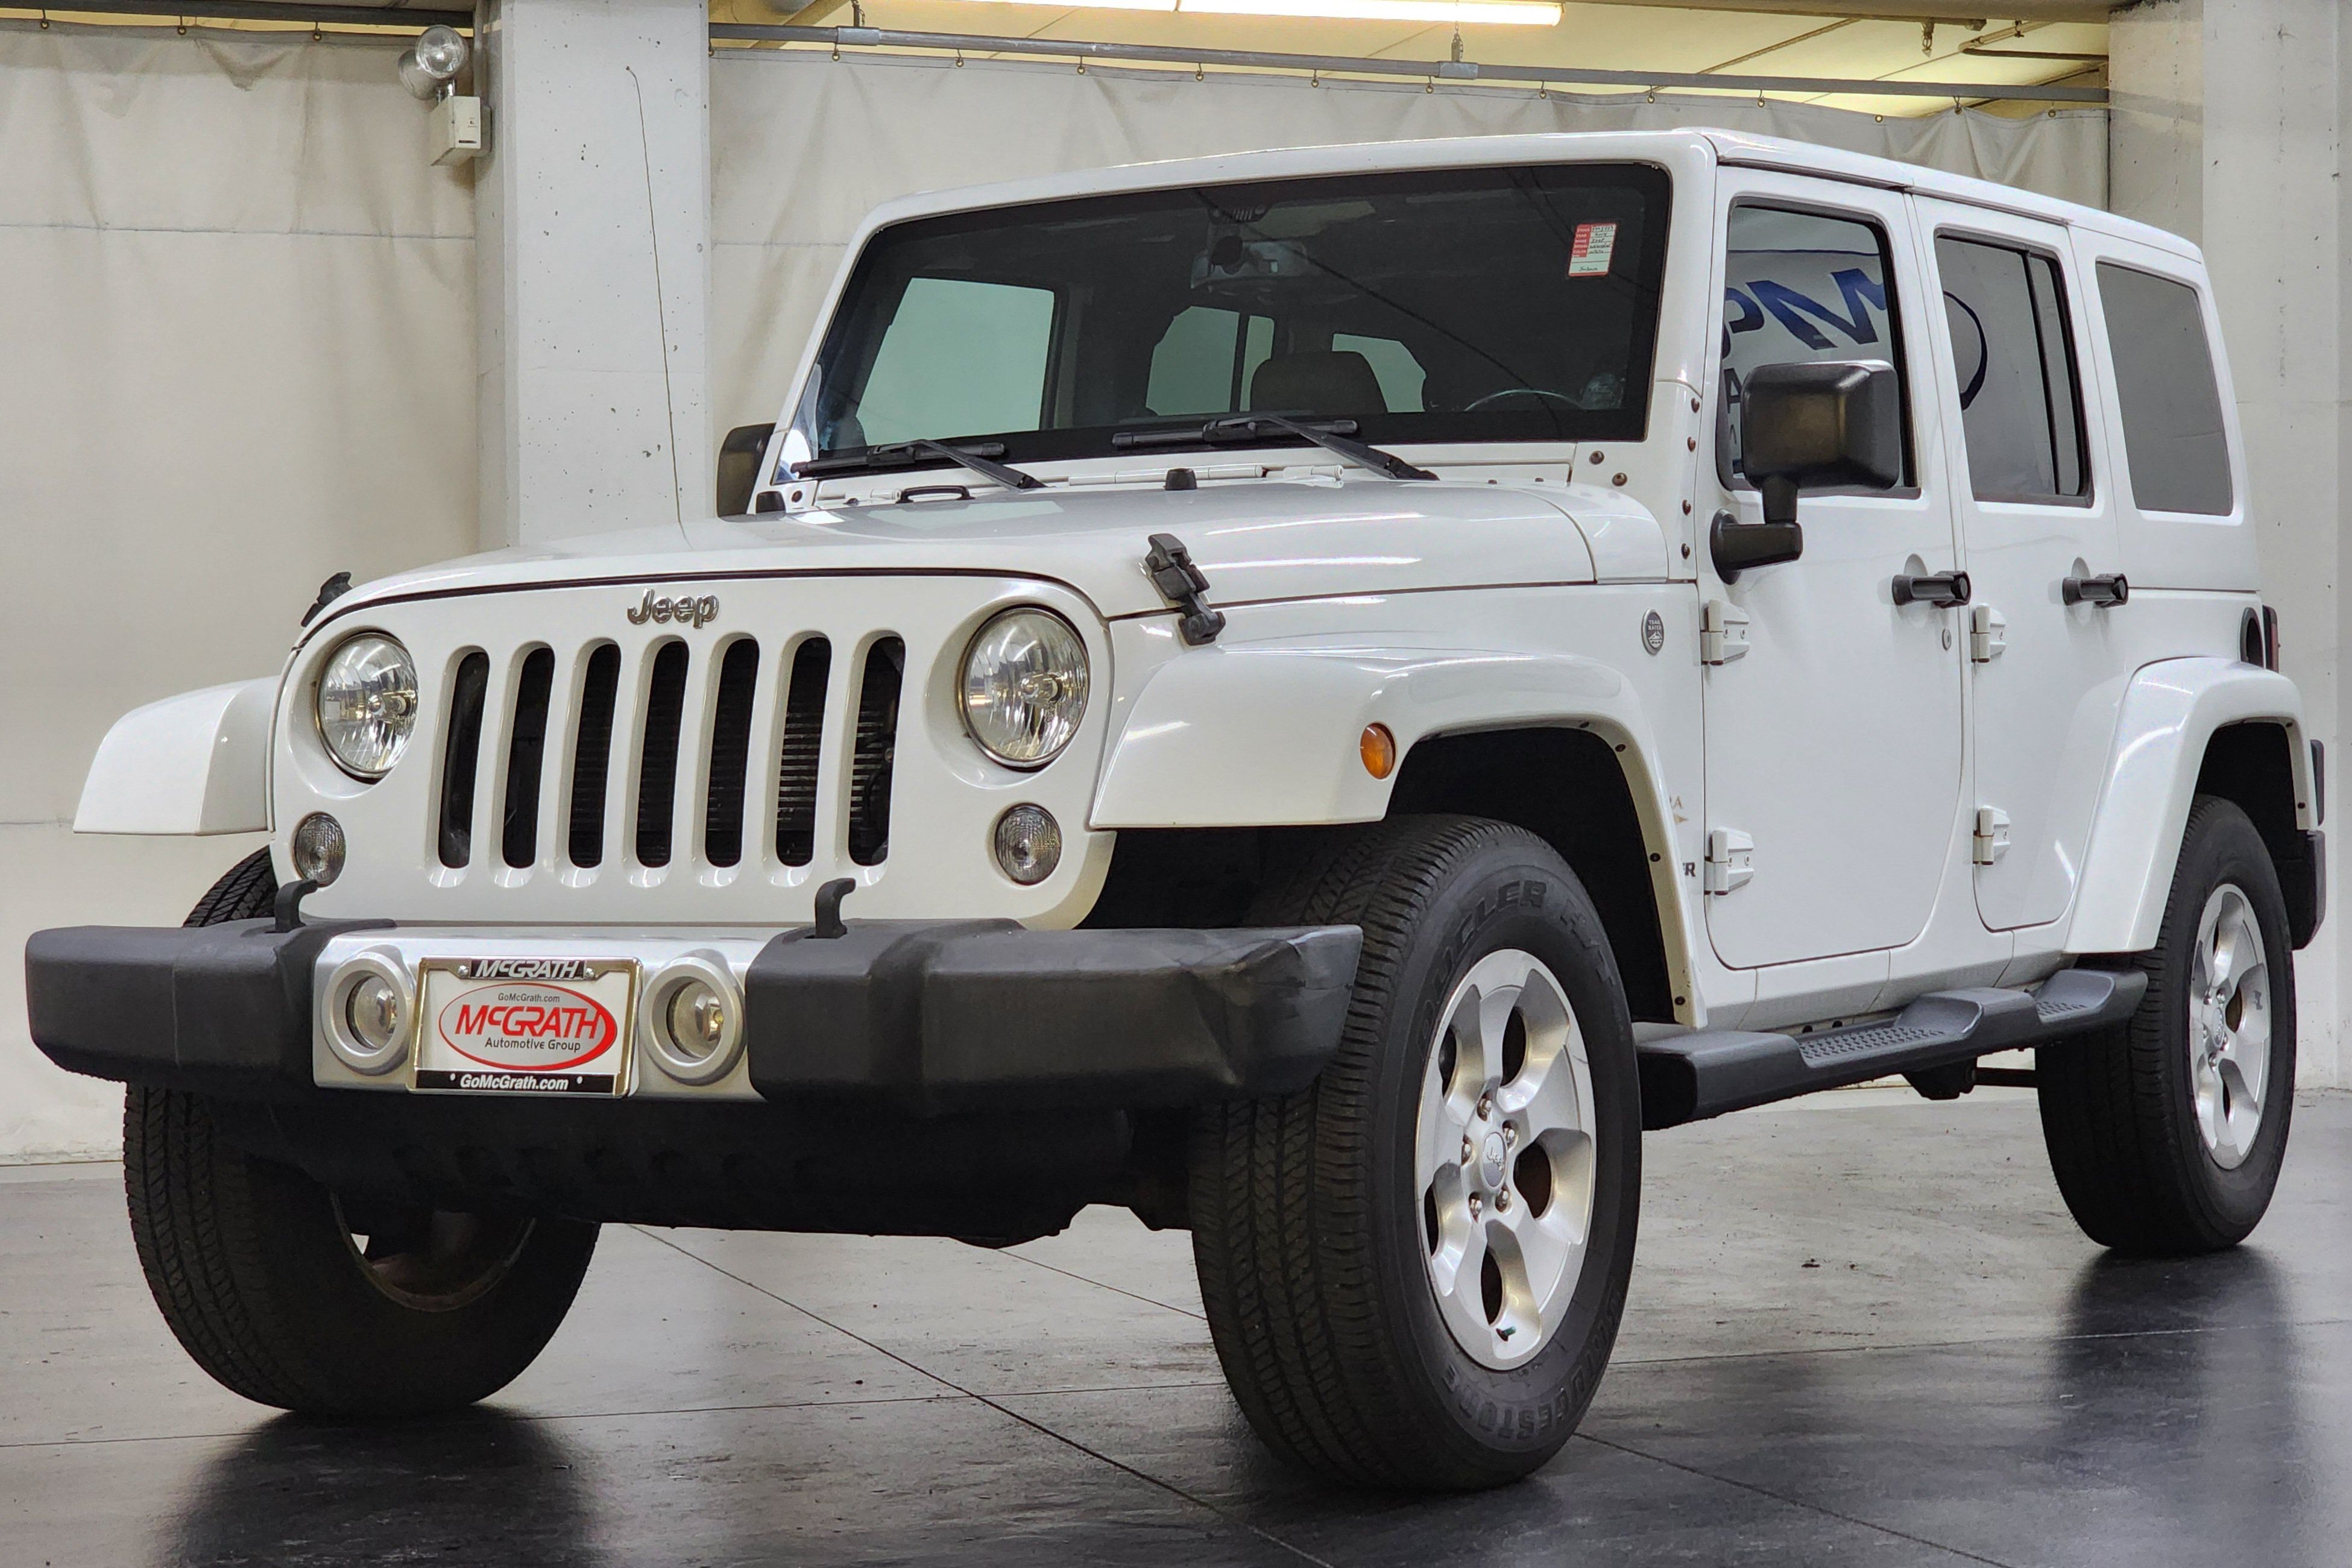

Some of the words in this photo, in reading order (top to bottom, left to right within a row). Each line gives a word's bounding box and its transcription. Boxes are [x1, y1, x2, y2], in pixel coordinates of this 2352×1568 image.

[627, 588, 719, 629] Jeep
[498, 992, 560, 1003] GoMcGrath.com
[485, 1036, 544, 1050] Automotive
[547, 1039, 581, 1053] Group
[460, 1074, 569, 1090] GoMcGrath.com
